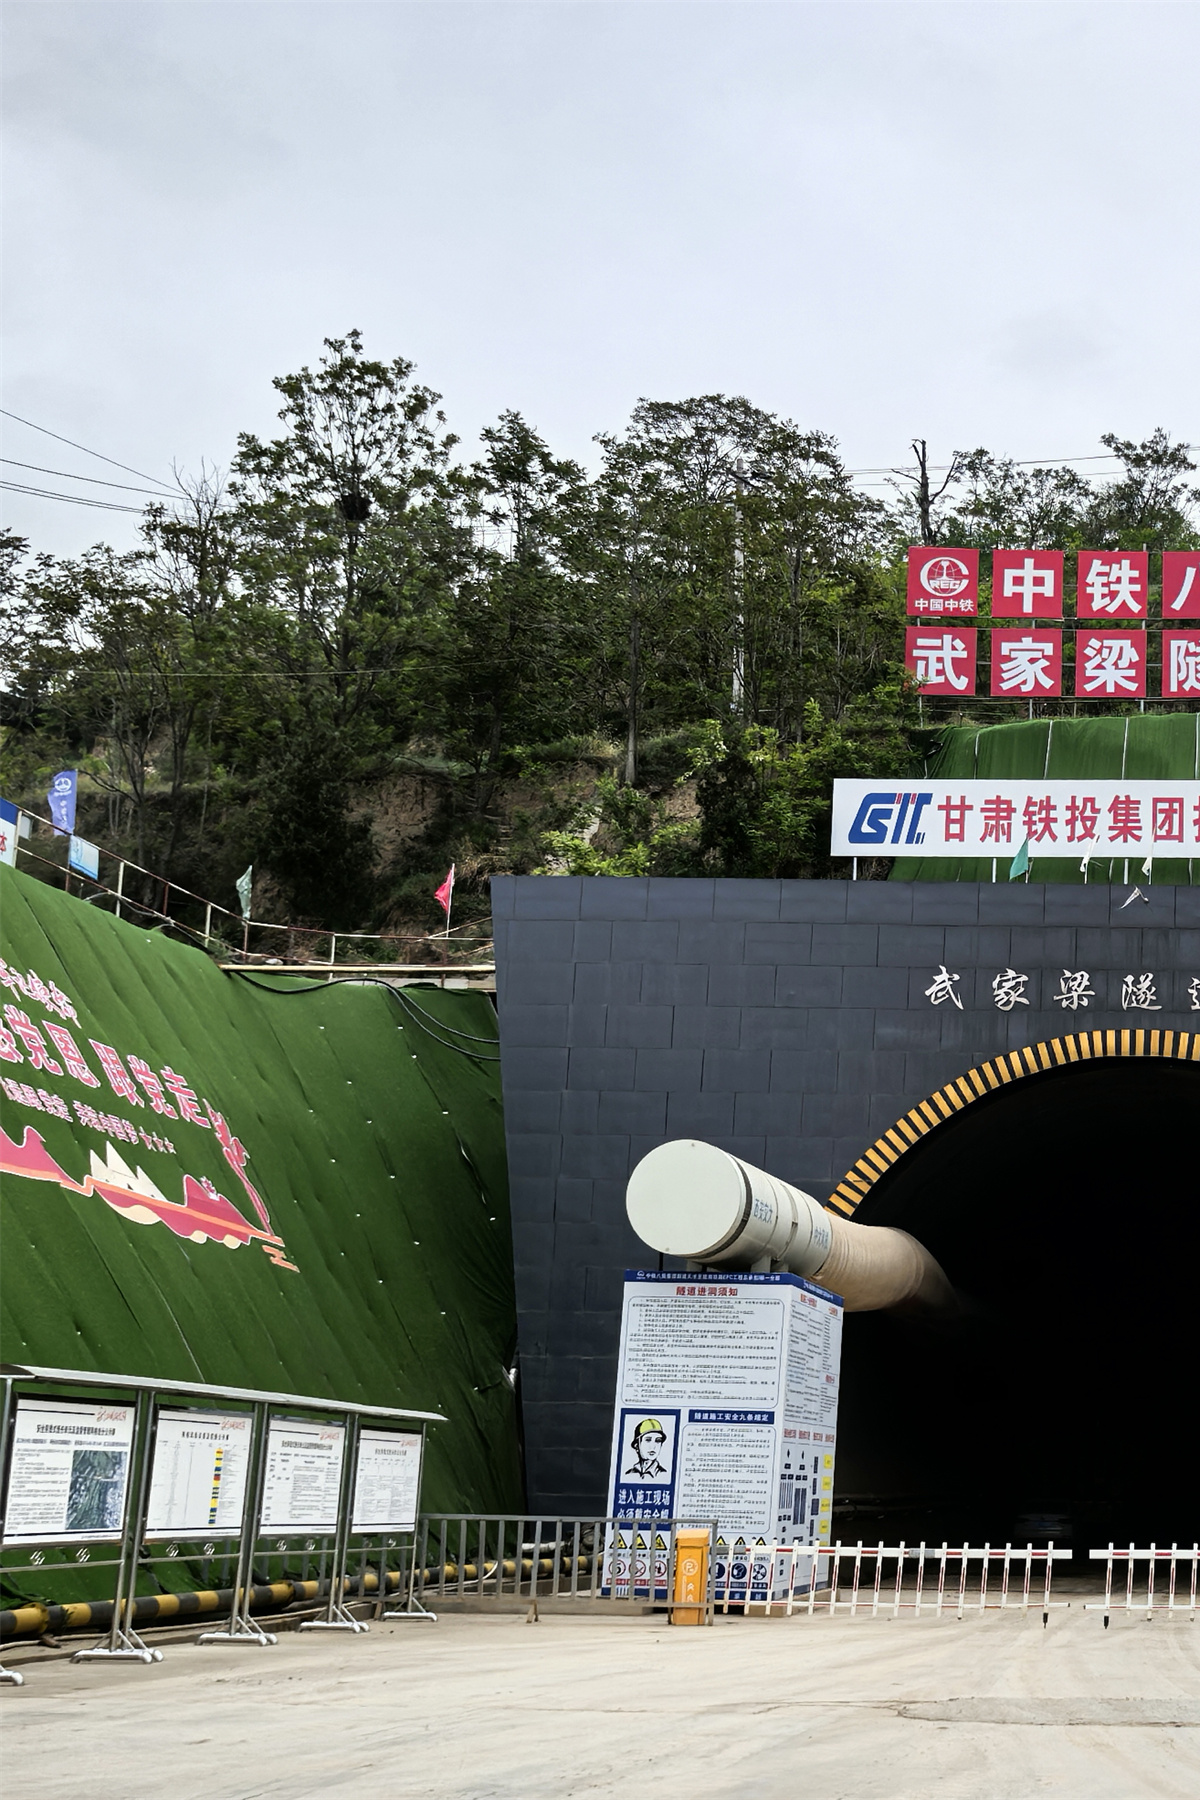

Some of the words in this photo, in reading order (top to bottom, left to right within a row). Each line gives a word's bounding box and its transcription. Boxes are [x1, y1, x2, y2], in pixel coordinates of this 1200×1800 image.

[914, 598, 975, 612] 中国中铁
[88, 1038, 212, 1129] 跟党走
[675, 1286, 739, 1297] 隧道进洞须知
[693, 1412, 770, 1422] 隧道施工安全九条规定
[618, 1488, 671, 1506] 进入施工现场
